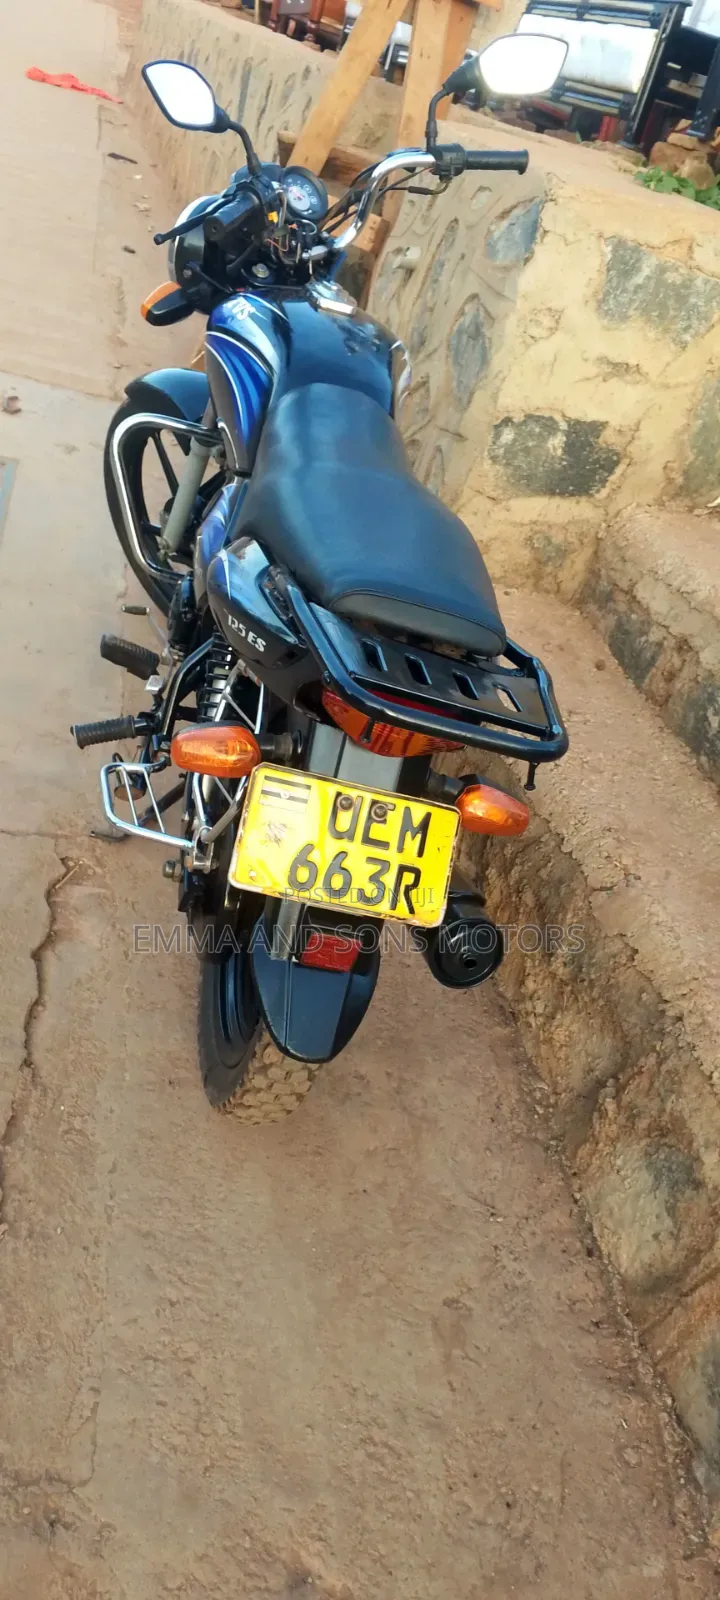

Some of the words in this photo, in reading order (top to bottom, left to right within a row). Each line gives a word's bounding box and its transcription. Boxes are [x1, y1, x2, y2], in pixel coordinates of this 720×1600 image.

[228, 614, 247, 637] 125
[247, 631, 266, 652] ES
[328, 791, 432, 858] UEM
[287, 843, 422, 915] 663R
